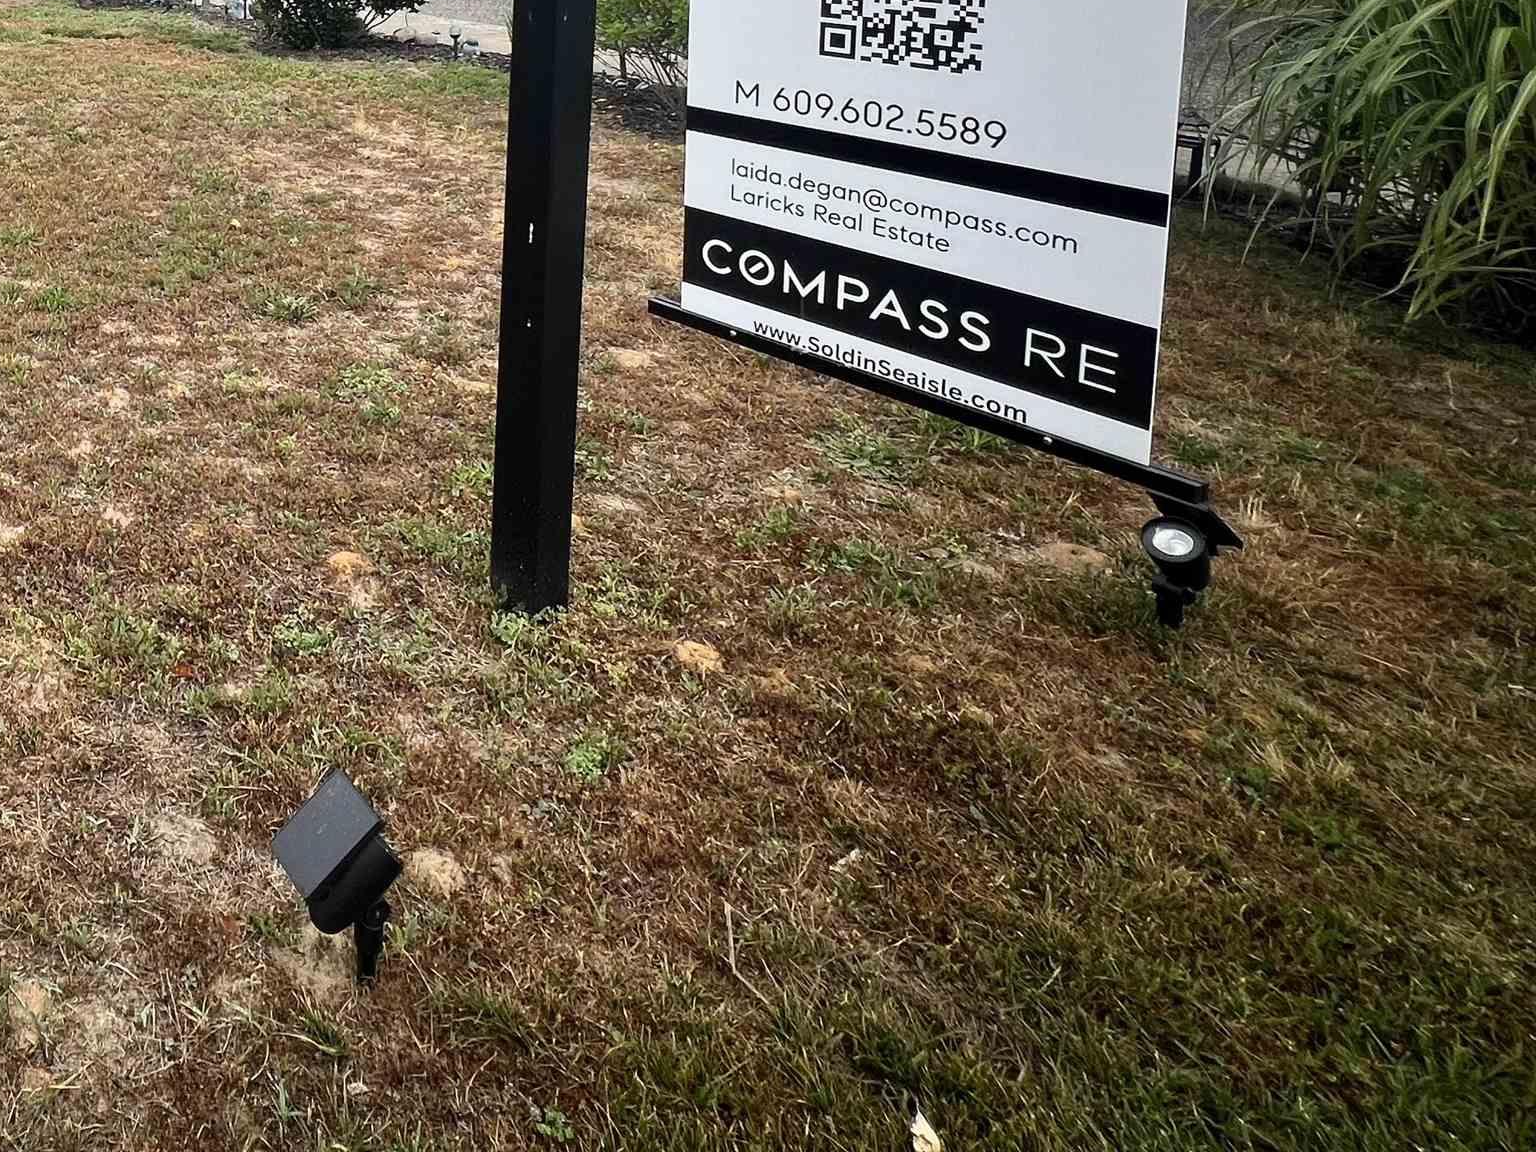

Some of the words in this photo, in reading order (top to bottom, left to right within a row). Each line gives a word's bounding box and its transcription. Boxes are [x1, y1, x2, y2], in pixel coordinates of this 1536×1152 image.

[735, 79, 760, 107] M
[772, 87, 1008, 149] 609.602.5589
[730, 183, 805, 218] Laricks
[813, 203, 863, 232] Real
[872, 217, 951, 253] Estate
[731, 157, 1078, 254] laida.degan@compass.com
[701, 238, 992, 354] COMPASS
[1023, 327, 1120, 394] RE
[752, 319, 1028, 424] www.SoldinSeaisle.com
